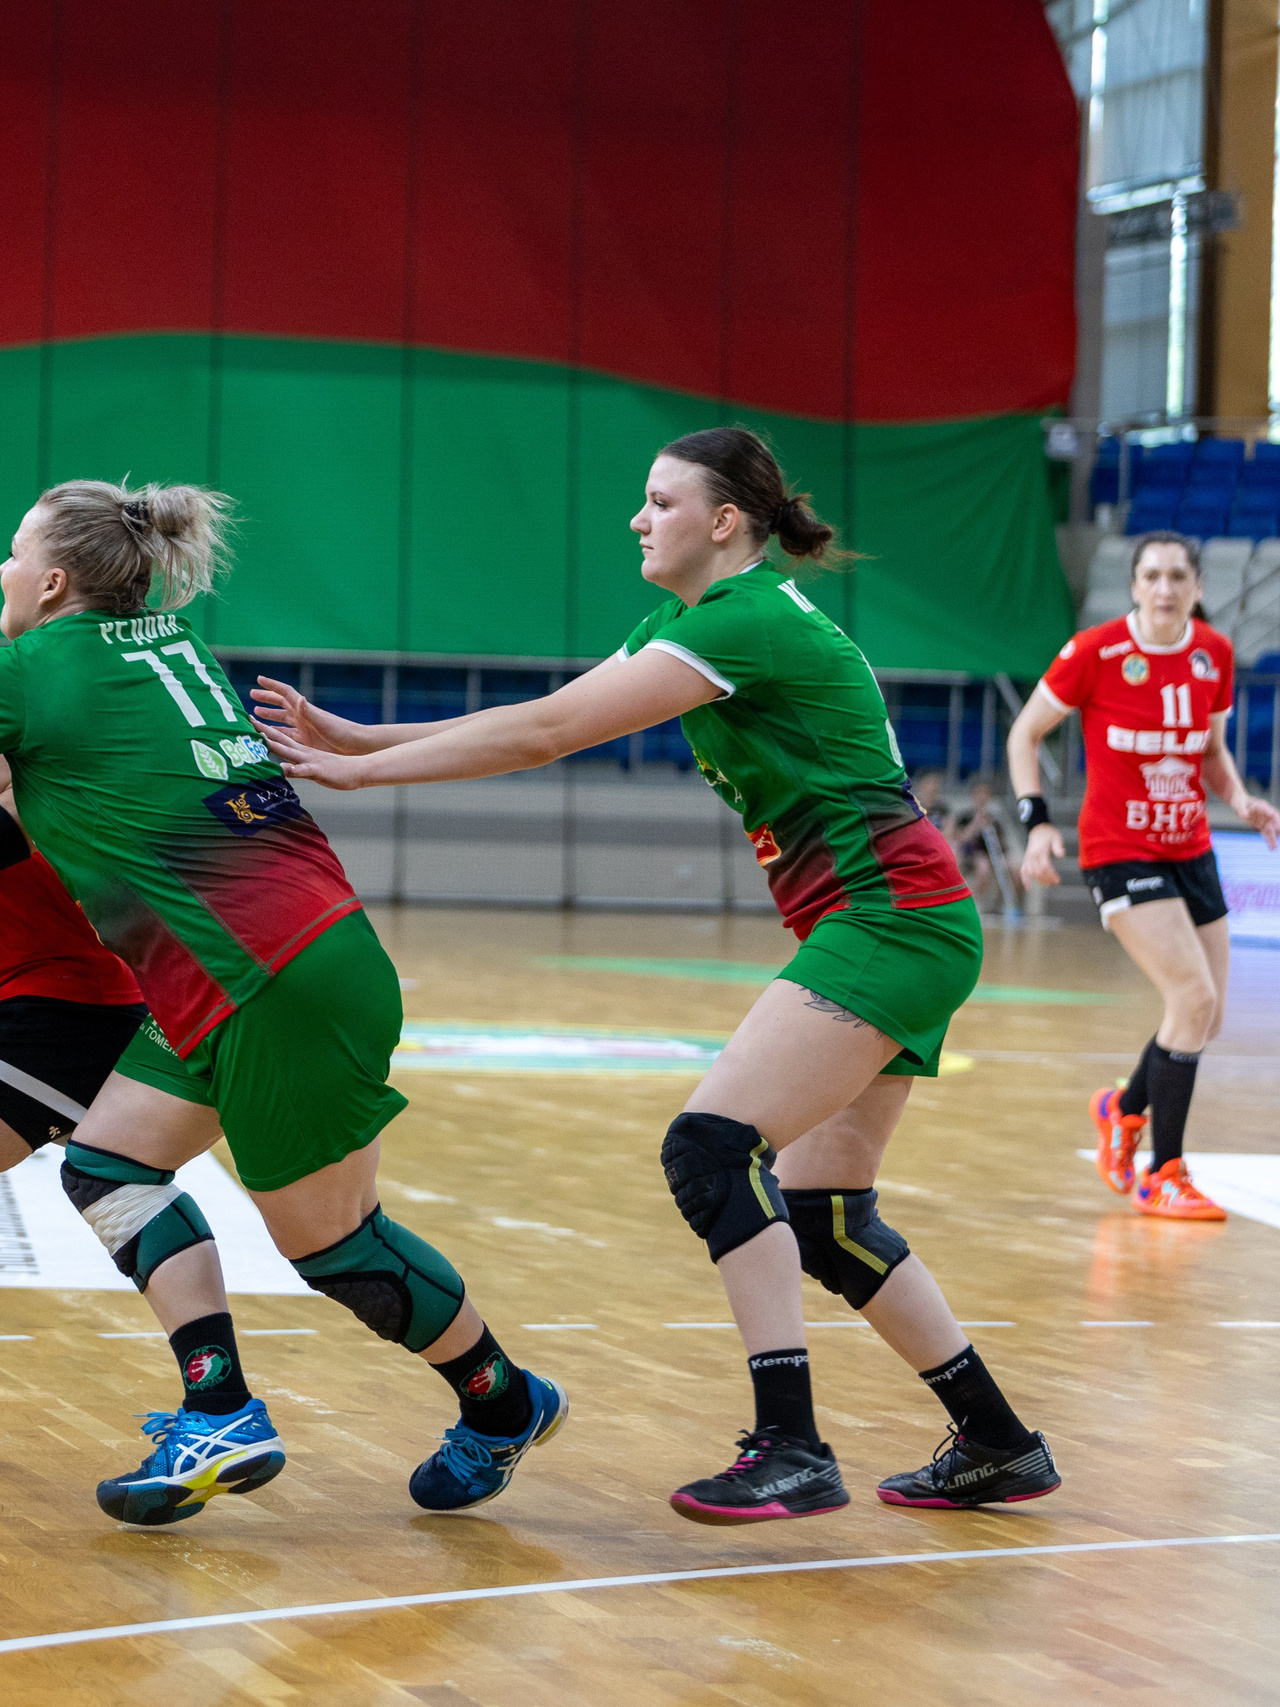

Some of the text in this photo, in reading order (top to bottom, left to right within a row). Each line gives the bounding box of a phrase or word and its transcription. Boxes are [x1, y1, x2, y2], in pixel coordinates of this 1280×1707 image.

[121, 640, 237, 728] 77
[1161, 683, 1193, 728] 11
[144, 1026, 178, 1056] ГОМЕ
[924, 1358, 970, 1385] empa
